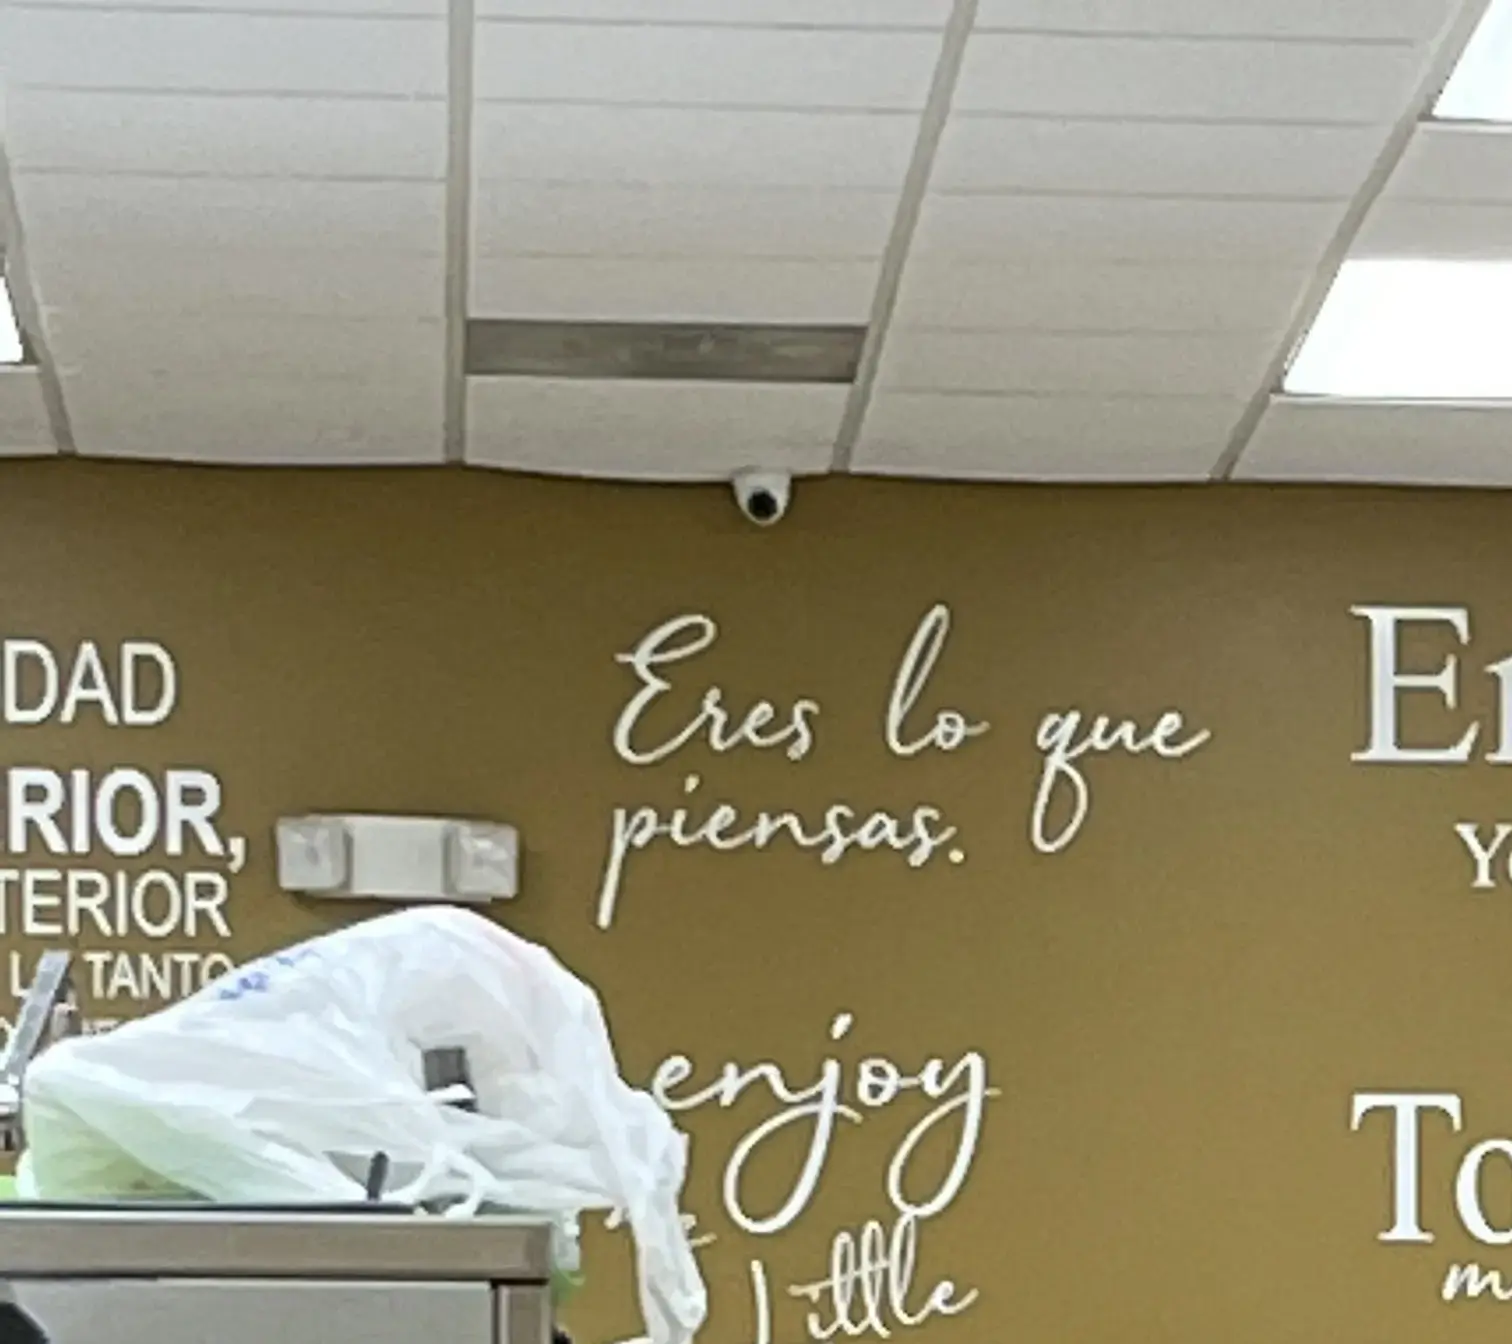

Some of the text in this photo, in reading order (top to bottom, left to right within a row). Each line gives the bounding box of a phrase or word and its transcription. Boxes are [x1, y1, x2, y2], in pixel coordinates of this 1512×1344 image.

[613, 604, 1212, 854] Eres lo que
[597, 774, 965, 930] piensas.
[651, 1012, 1002, 1234] enjoy
